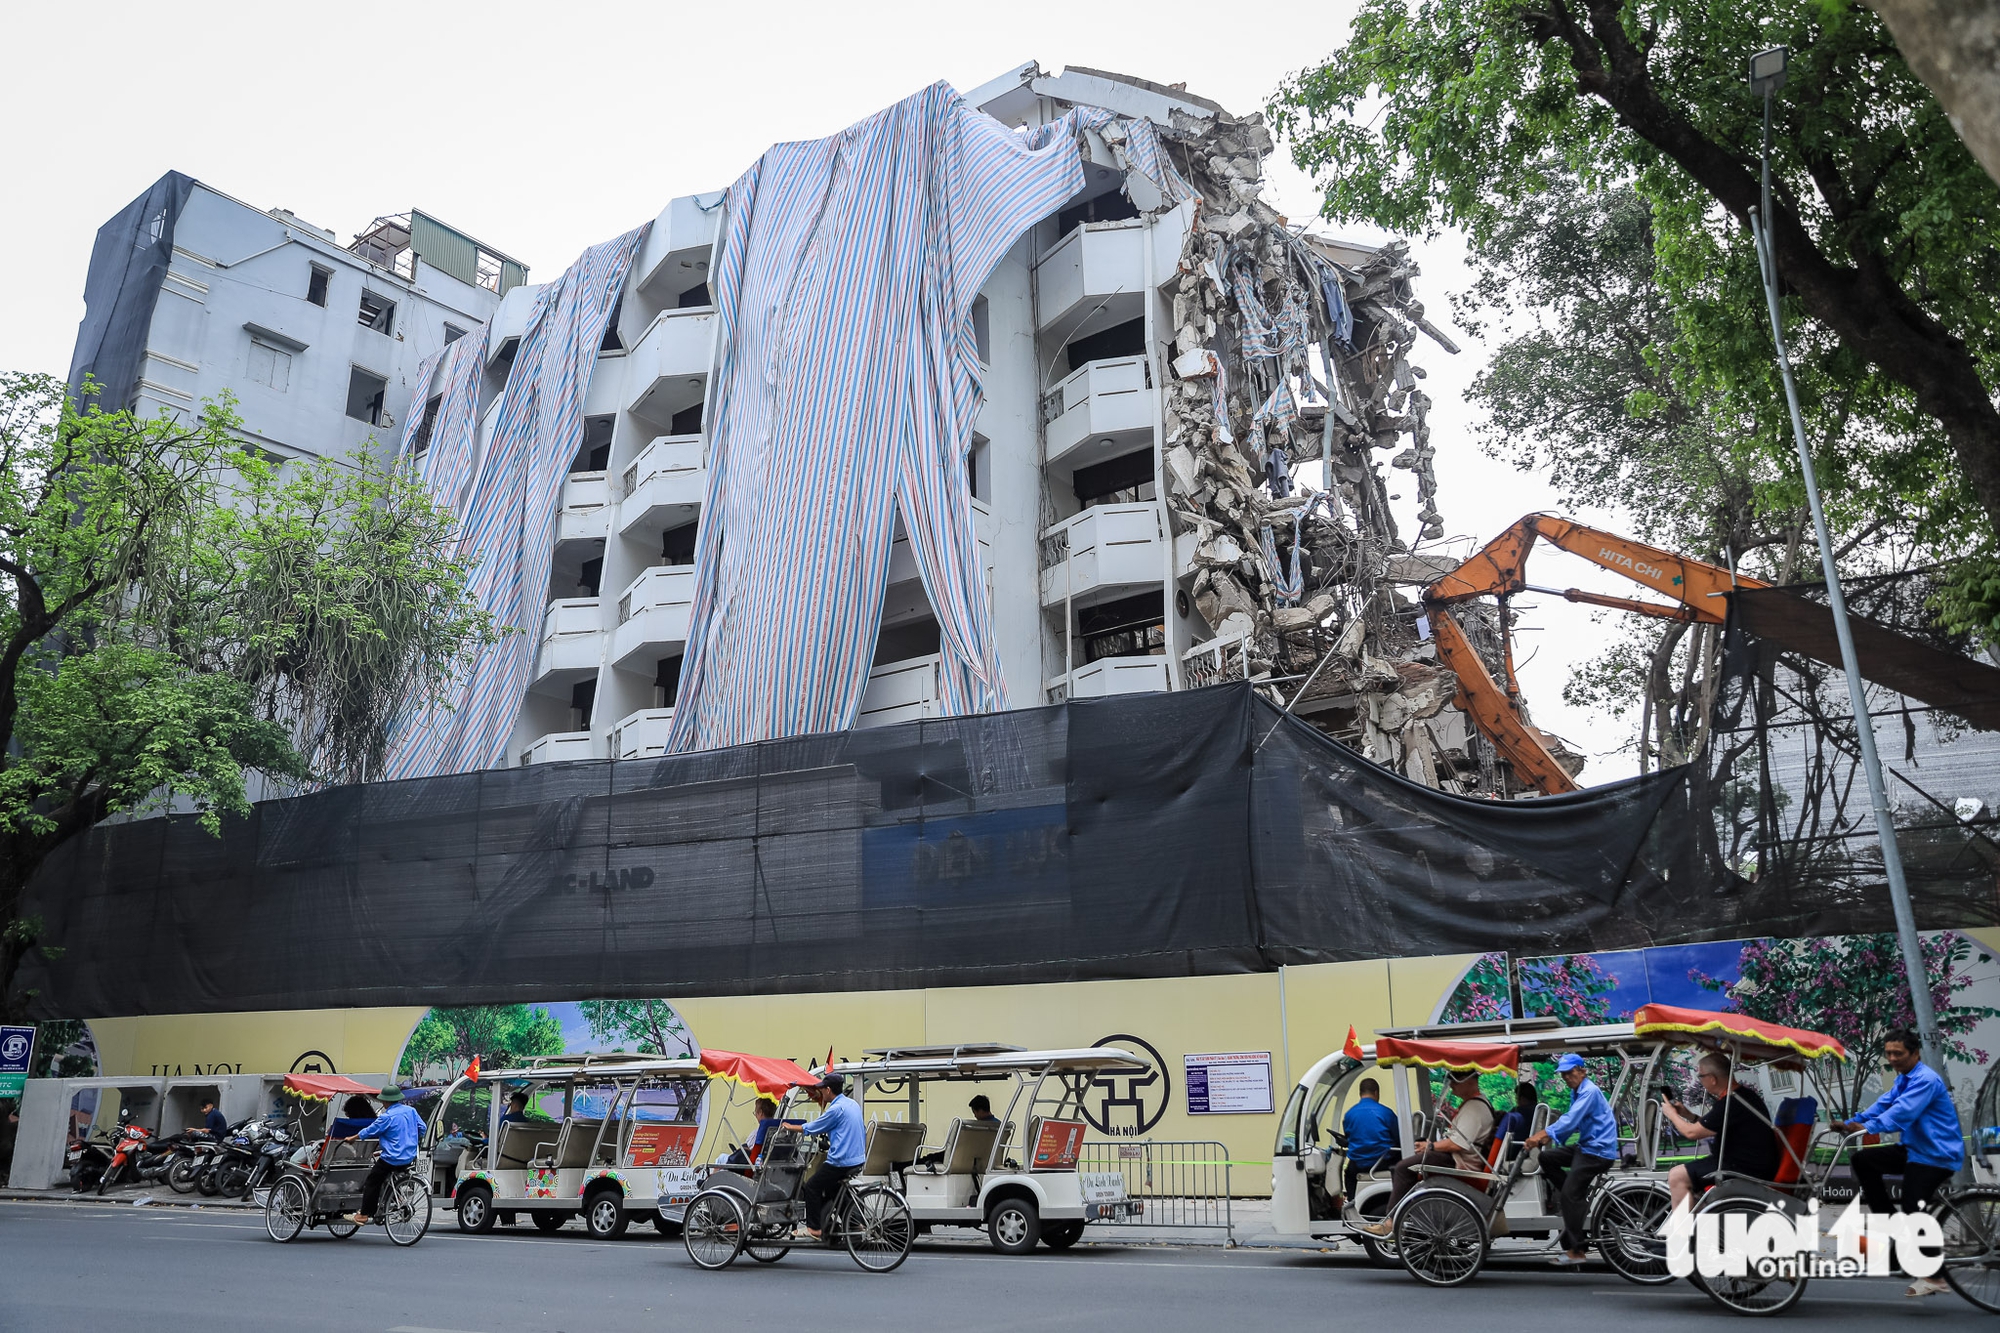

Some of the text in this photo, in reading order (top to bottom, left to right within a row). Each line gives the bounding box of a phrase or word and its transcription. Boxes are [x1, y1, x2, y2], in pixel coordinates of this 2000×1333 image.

[1598, 547, 1663, 580] HITACHI
[1110, 1125, 1138, 1138] HÀ NỘI
[665, 1170, 679, 1182] Du
[1822, 1186, 1853, 1197] Hoàn
